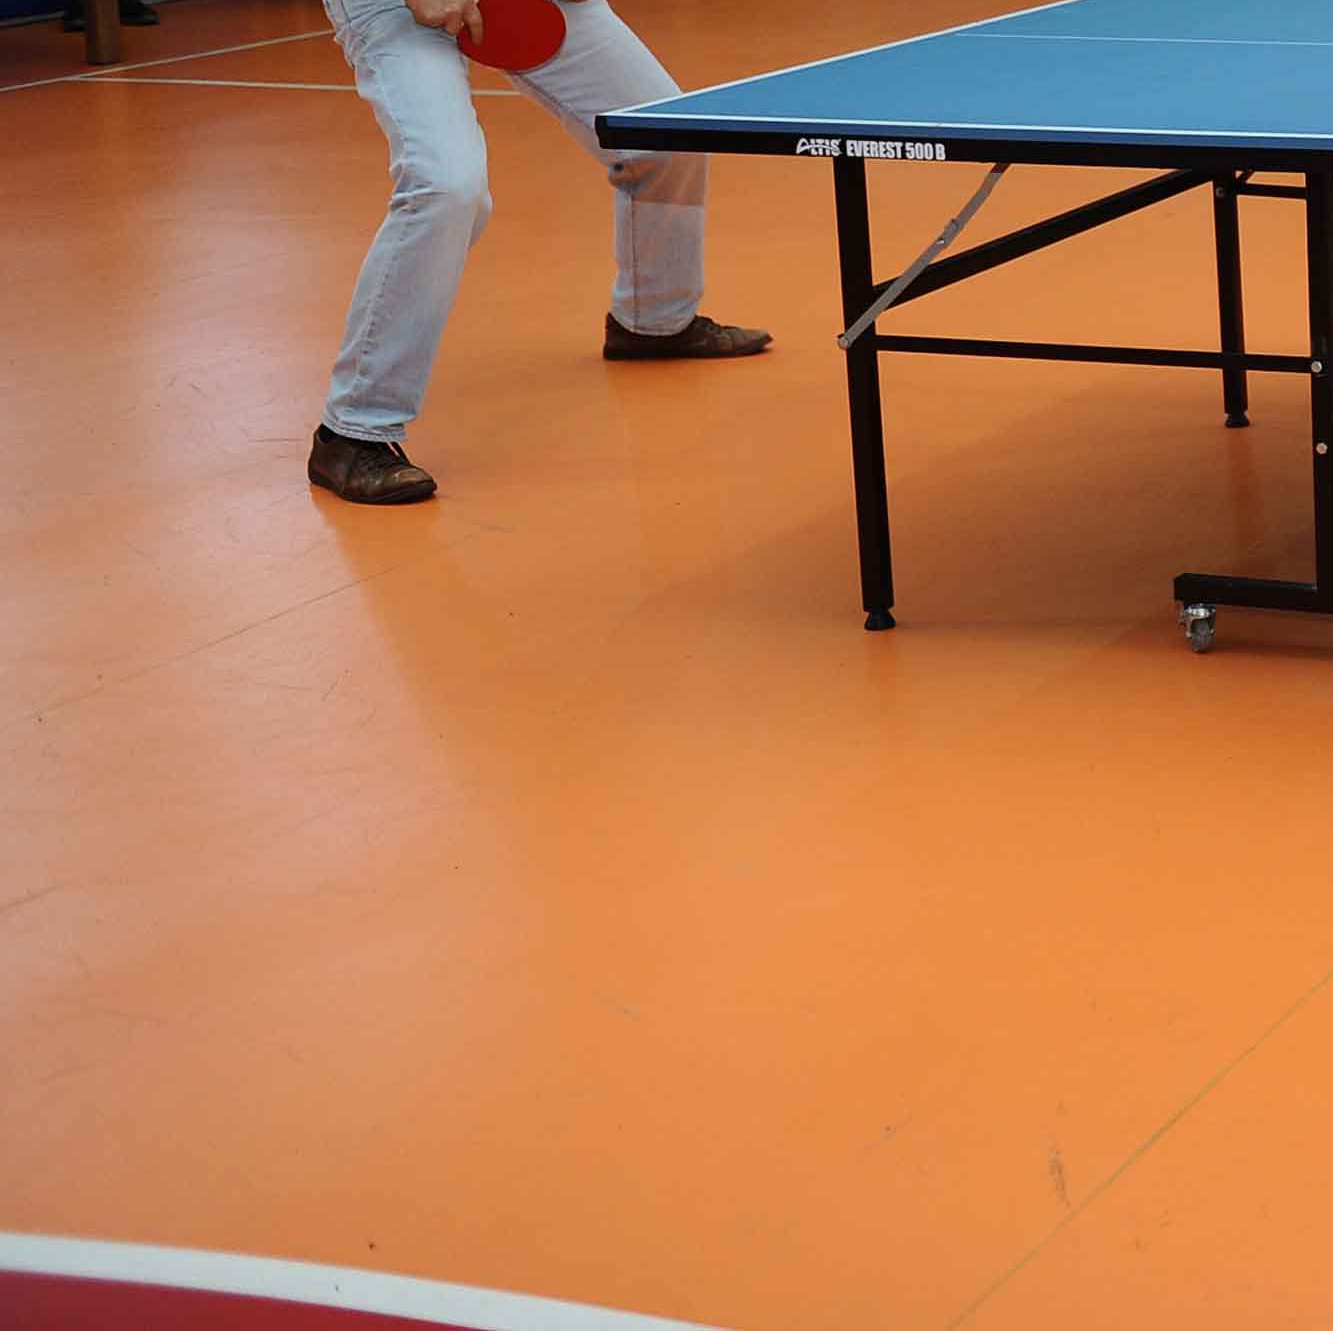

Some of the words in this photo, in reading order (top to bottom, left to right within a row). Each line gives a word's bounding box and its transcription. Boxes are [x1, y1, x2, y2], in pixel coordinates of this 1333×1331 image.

[846, 140, 903, 158] EVEREST
[905, 143, 934, 160] 500
[935, 143, 946, 160] B
